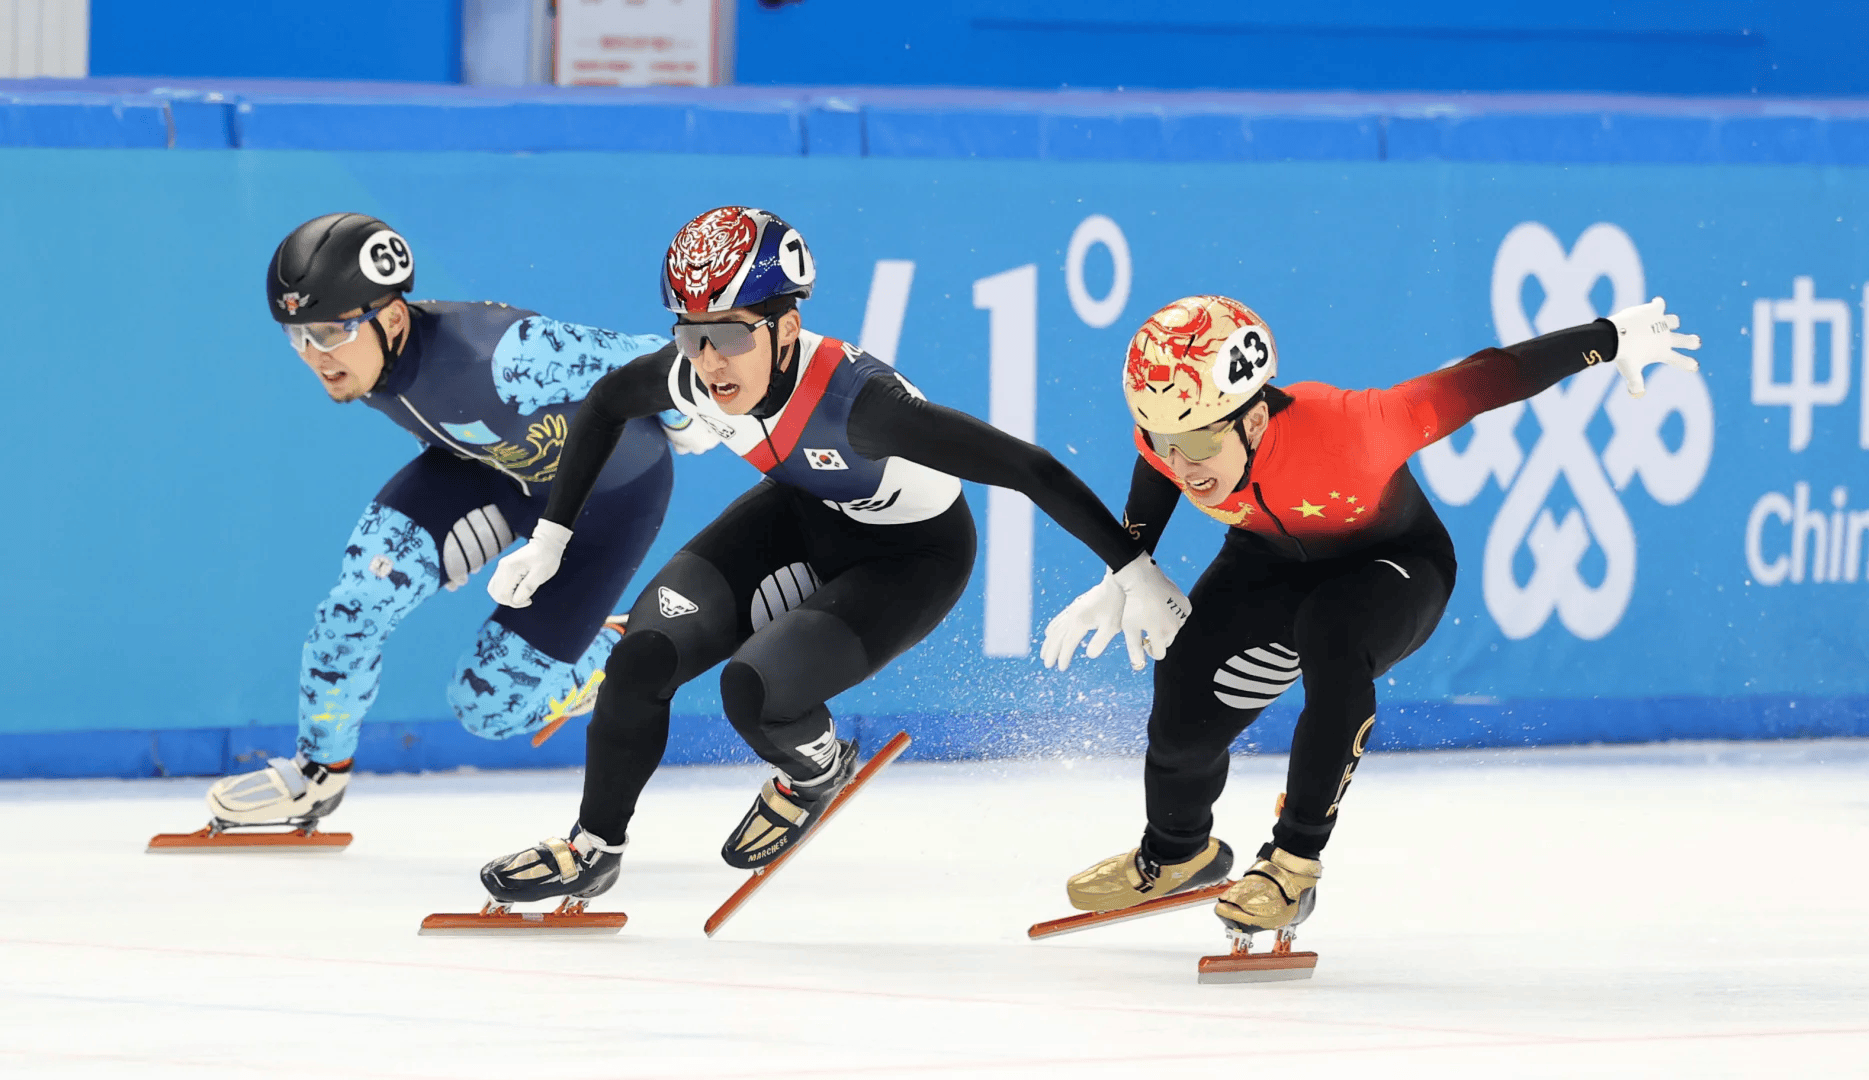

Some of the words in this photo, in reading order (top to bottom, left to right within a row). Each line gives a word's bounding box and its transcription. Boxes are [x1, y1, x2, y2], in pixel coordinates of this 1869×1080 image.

[370, 237, 410, 277] 69
[1228, 331, 1269, 385] 43
[1751, 275, 1869, 452] 中
[747, 835, 789, 862] MARCHESE
